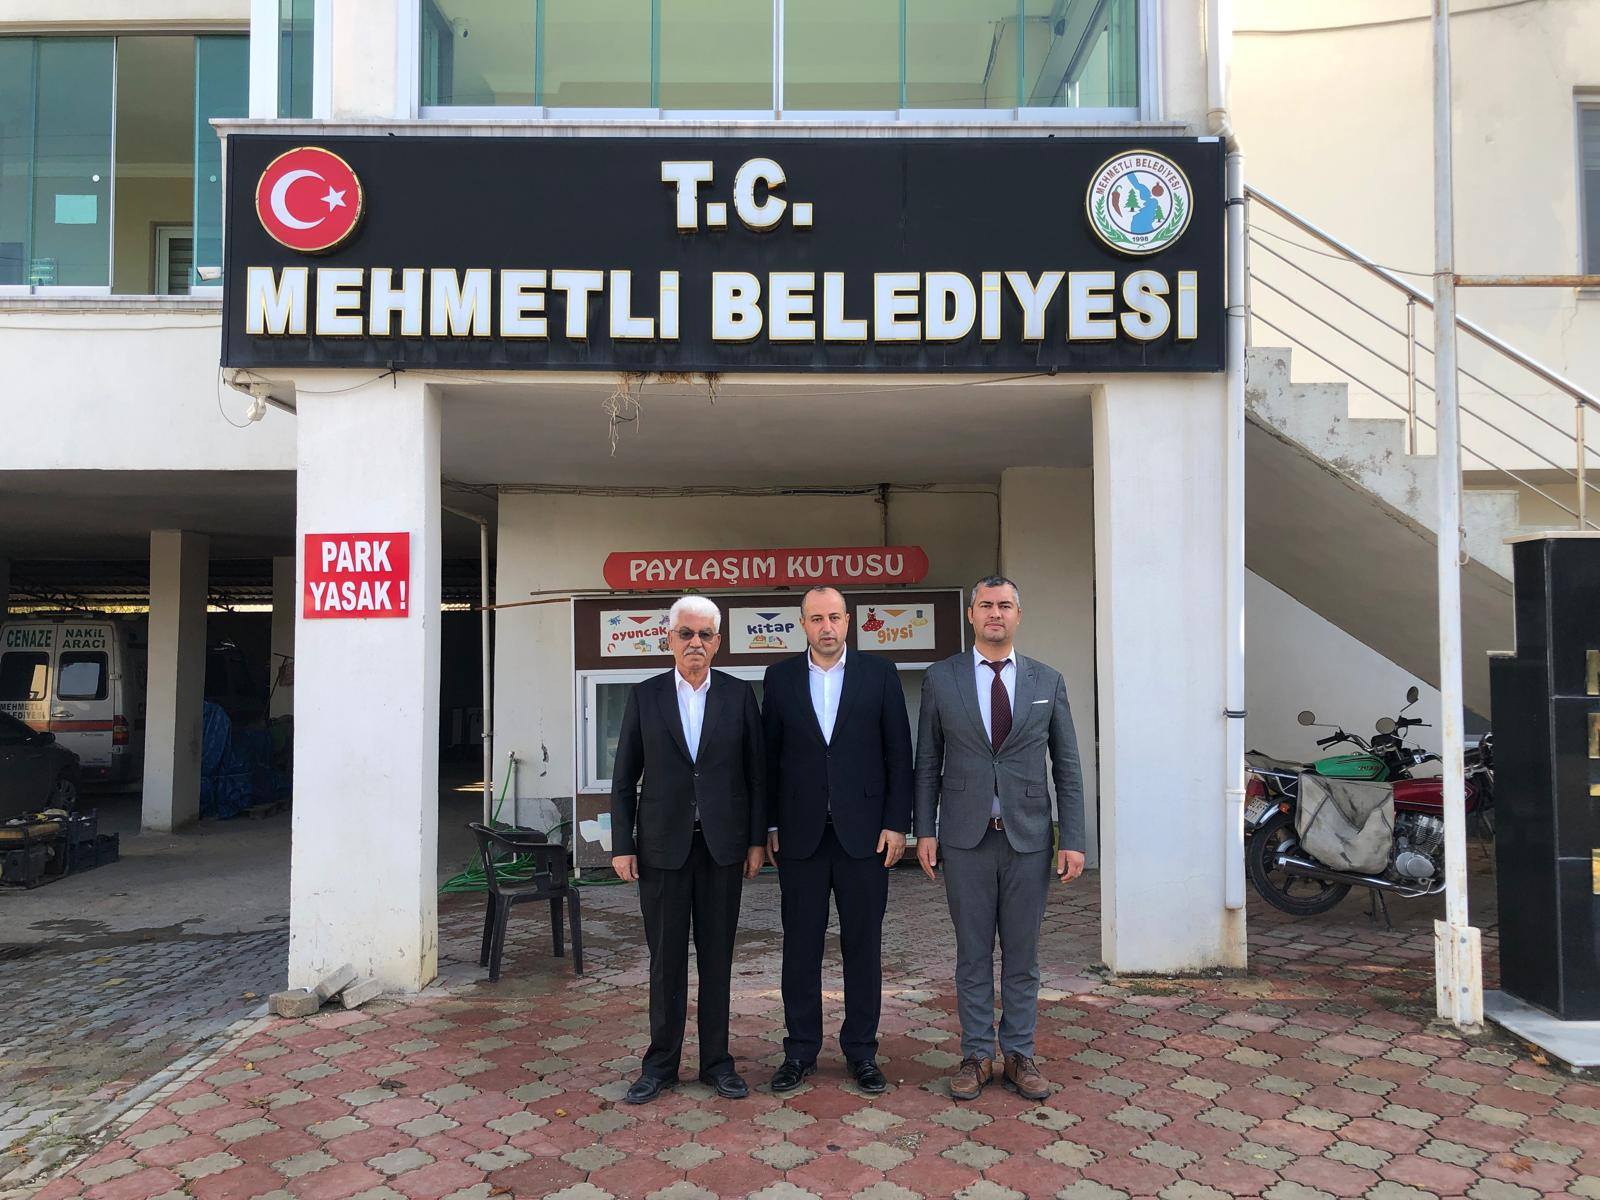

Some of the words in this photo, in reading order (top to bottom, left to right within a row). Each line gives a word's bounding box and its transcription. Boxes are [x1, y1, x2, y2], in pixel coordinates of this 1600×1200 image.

[661, 157, 813, 231] T.C.
[246, 266, 680, 340] MEHMETLİ
[711, 270, 1199, 342] BELEDİYESİ
[321, 540, 393, 573] PARK
[629, 557, 776, 585] PAYLAŞIM
[787, 554, 904, 578] KUTUSU
[7, 629, 52, 648] CENAZE
[65, 628, 105, 638] NAKİL
[611, 626, 668, 641] oyuncak
[746, 622, 795, 635] kitap
[877, 623, 914, 645] giysi
[62, 639, 106, 649] ARACI
